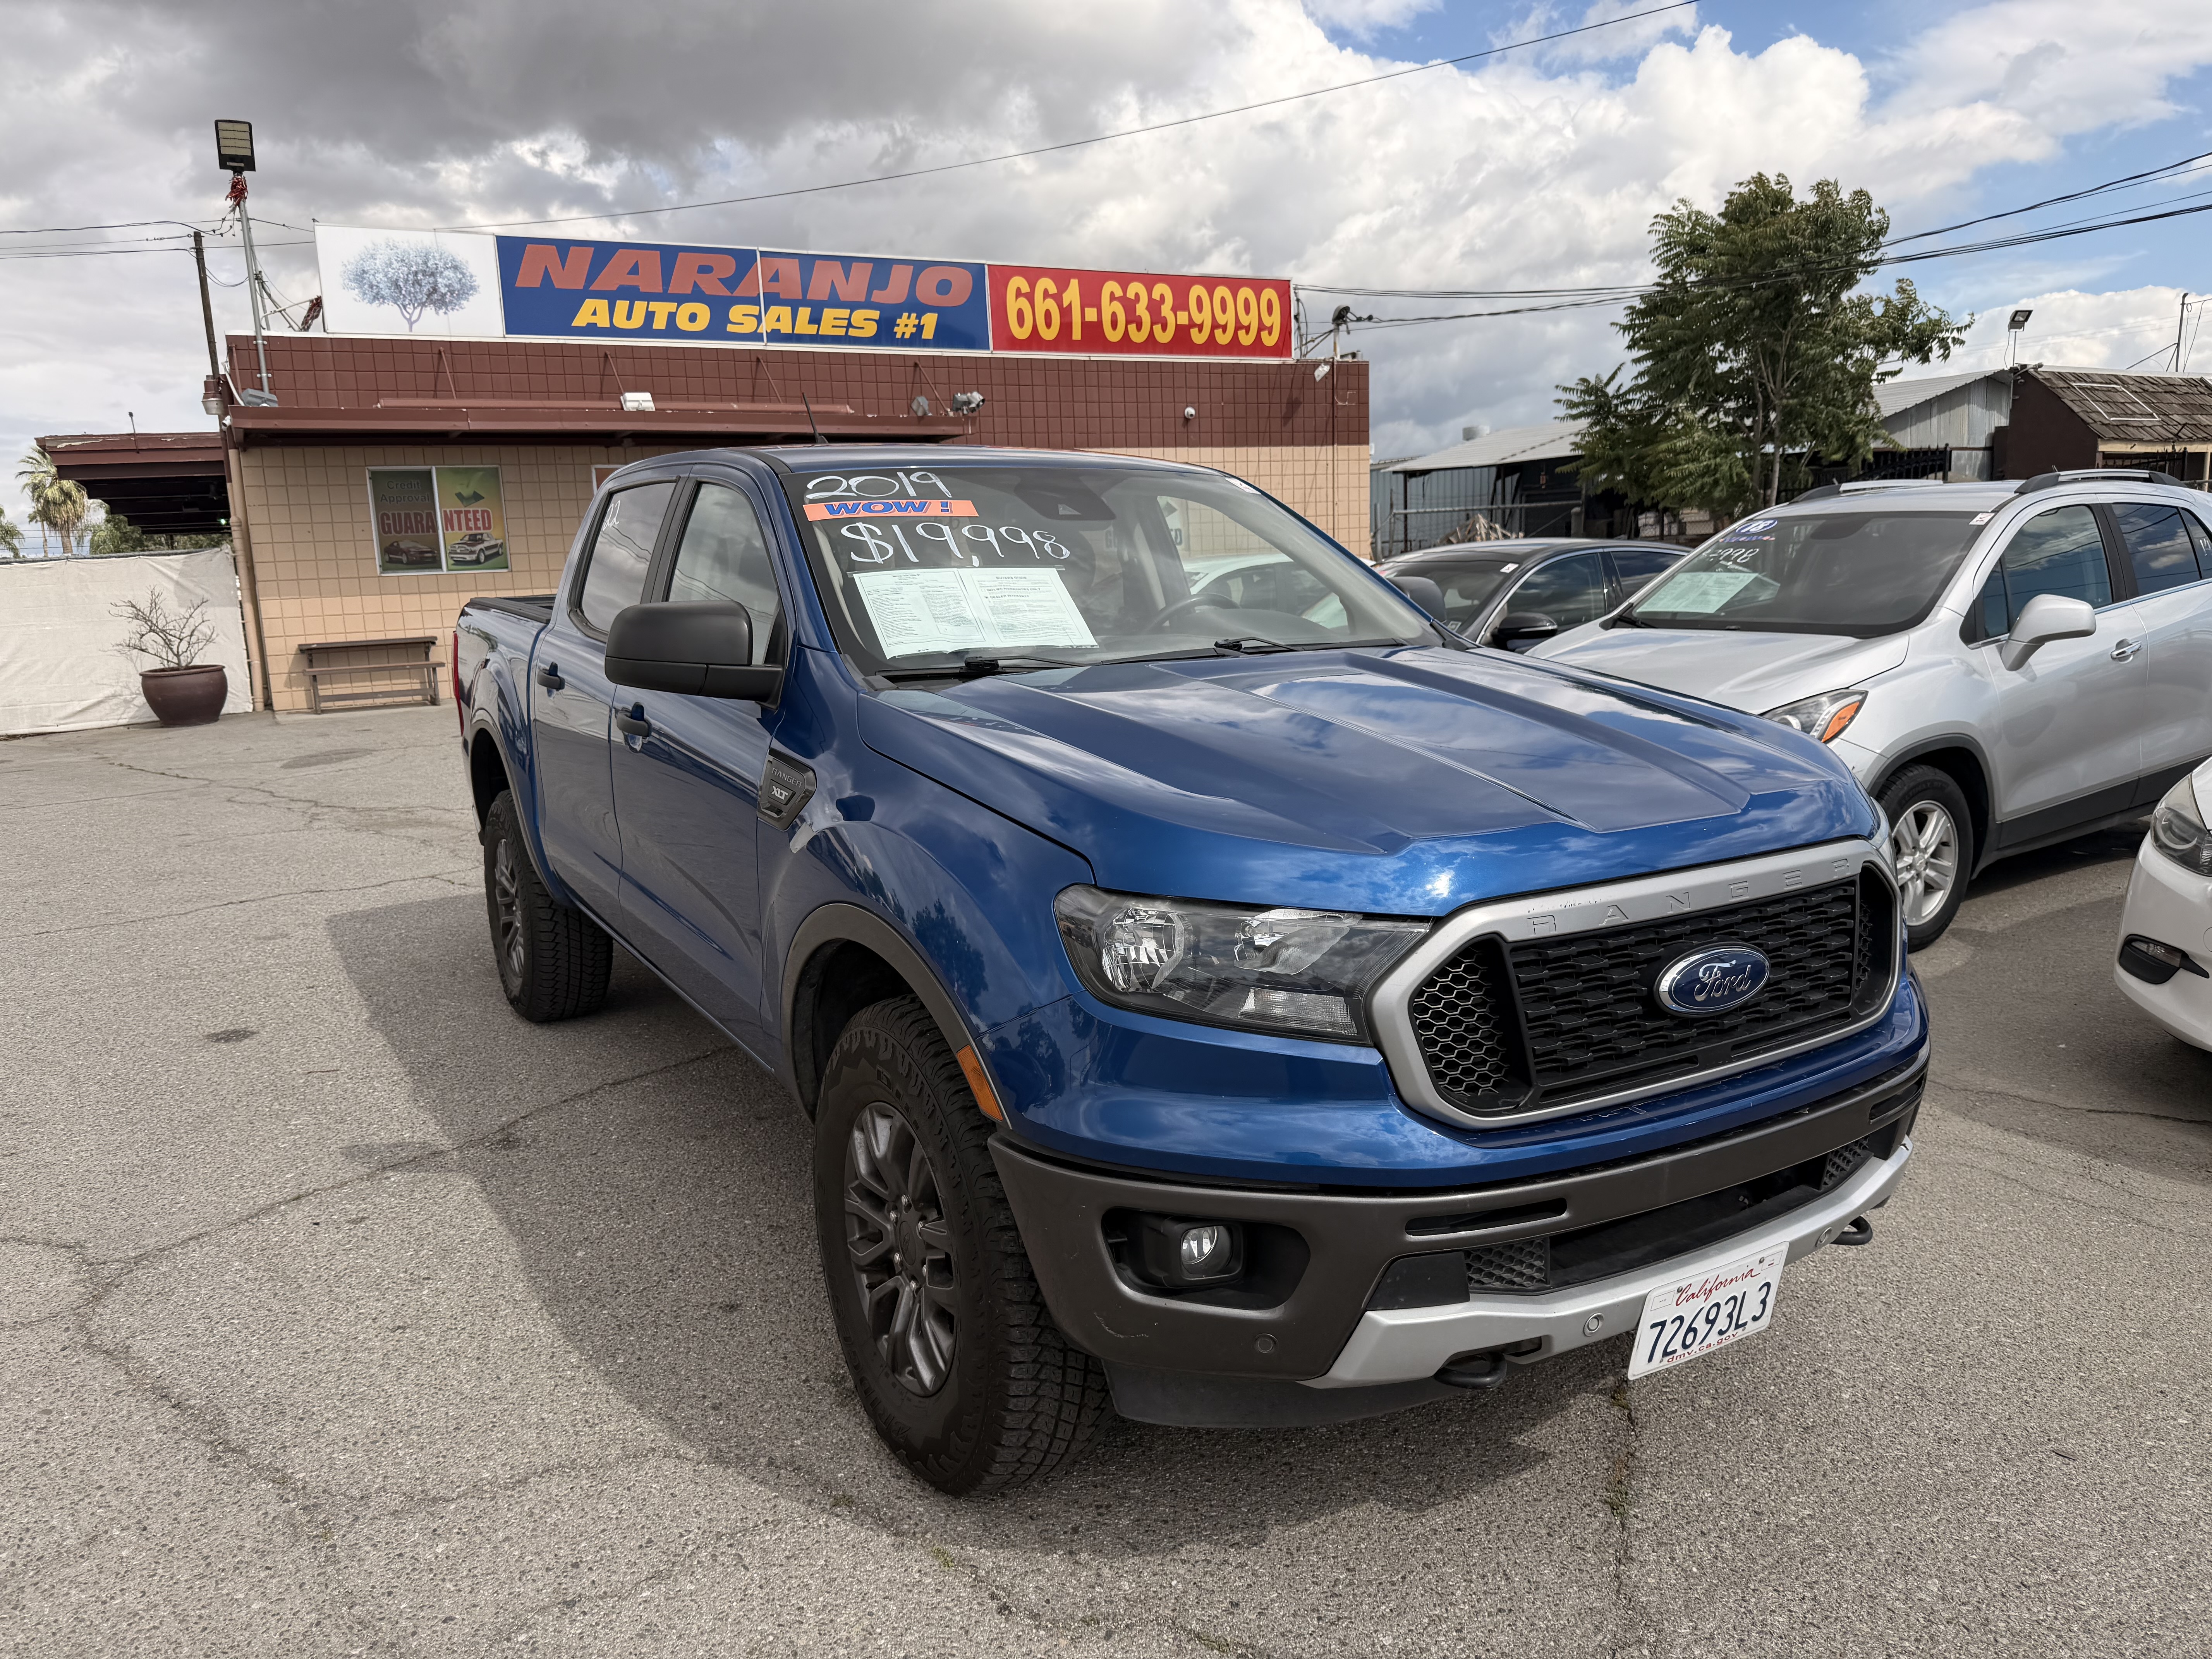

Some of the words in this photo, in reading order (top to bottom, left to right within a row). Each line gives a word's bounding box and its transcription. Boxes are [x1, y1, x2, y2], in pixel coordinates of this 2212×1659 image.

[515, 244, 973, 307] NARANJO
[572, 299, 710, 332] AUTO
[726, 305, 881, 338] SALES
[893, 313, 938, 339] #1
[1006, 276, 1281, 347] 661-633-9999
[380, 494, 430, 504] Approval
[386, 480, 421, 490] Credit
[806, 472, 953, 499] 2019
[380, 508, 493, 535] GUARANTEED
[824, 501, 931, 516] WOW
[841, 522, 1070, 567] $19,998
[771, 785, 788, 800] XLT
[772, 768, 802, 788] RANGER
[1527, 858, 1851, 935] RANGER
[1694, 959, 1752, 1001] Ford
[1675, 1265, 1760, 1307] California
[1647, 1281, 1771, 1363] 72693L3
[1667, 1331, 1738, 1363] dmv.ca.gov
